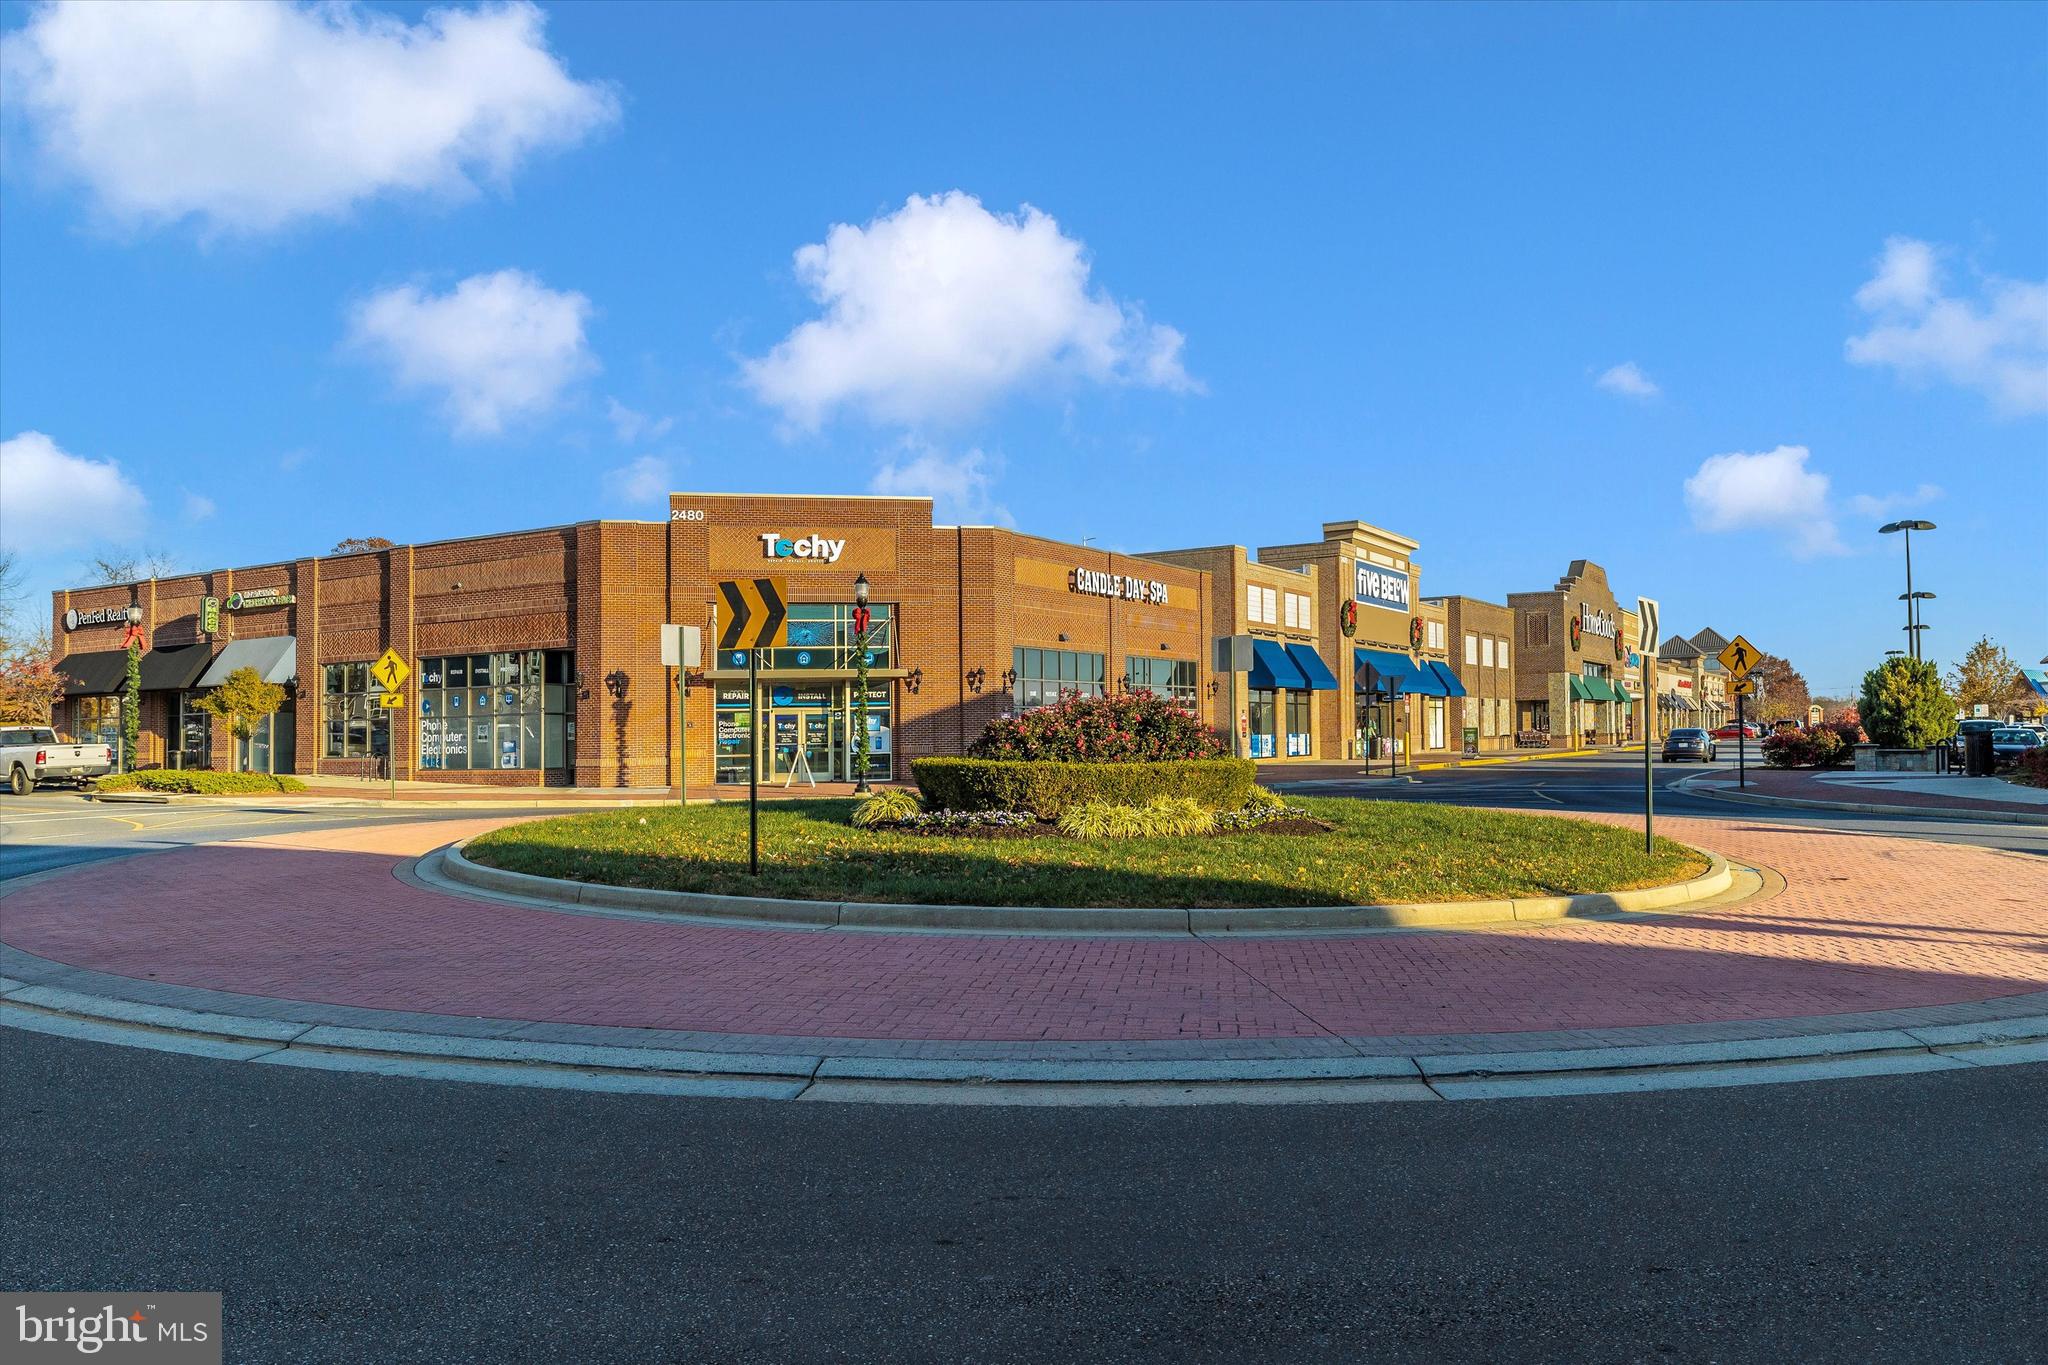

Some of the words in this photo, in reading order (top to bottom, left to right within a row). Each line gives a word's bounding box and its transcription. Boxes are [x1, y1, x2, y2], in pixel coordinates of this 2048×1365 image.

[672, 510, 704, 521] 2480
[762, 533, 846, 562] Techy
[1077, 567, 1120, 597] CANDLE
[1125, 576, 1145, 600] DAY
[1150, 580, 1168, 604] SPA
[1381, 574, 1408, 605] BELOW
[78, 609, 105, 625] PenFed
[1582, 602, 1616, 640] HomeGoods
[421, 672, 442, 684] Techy
[723, 692, 749, 700] REPAIR
[421, 719, 448, 731] Phone
[421, 743, 468, 755] Electonics
